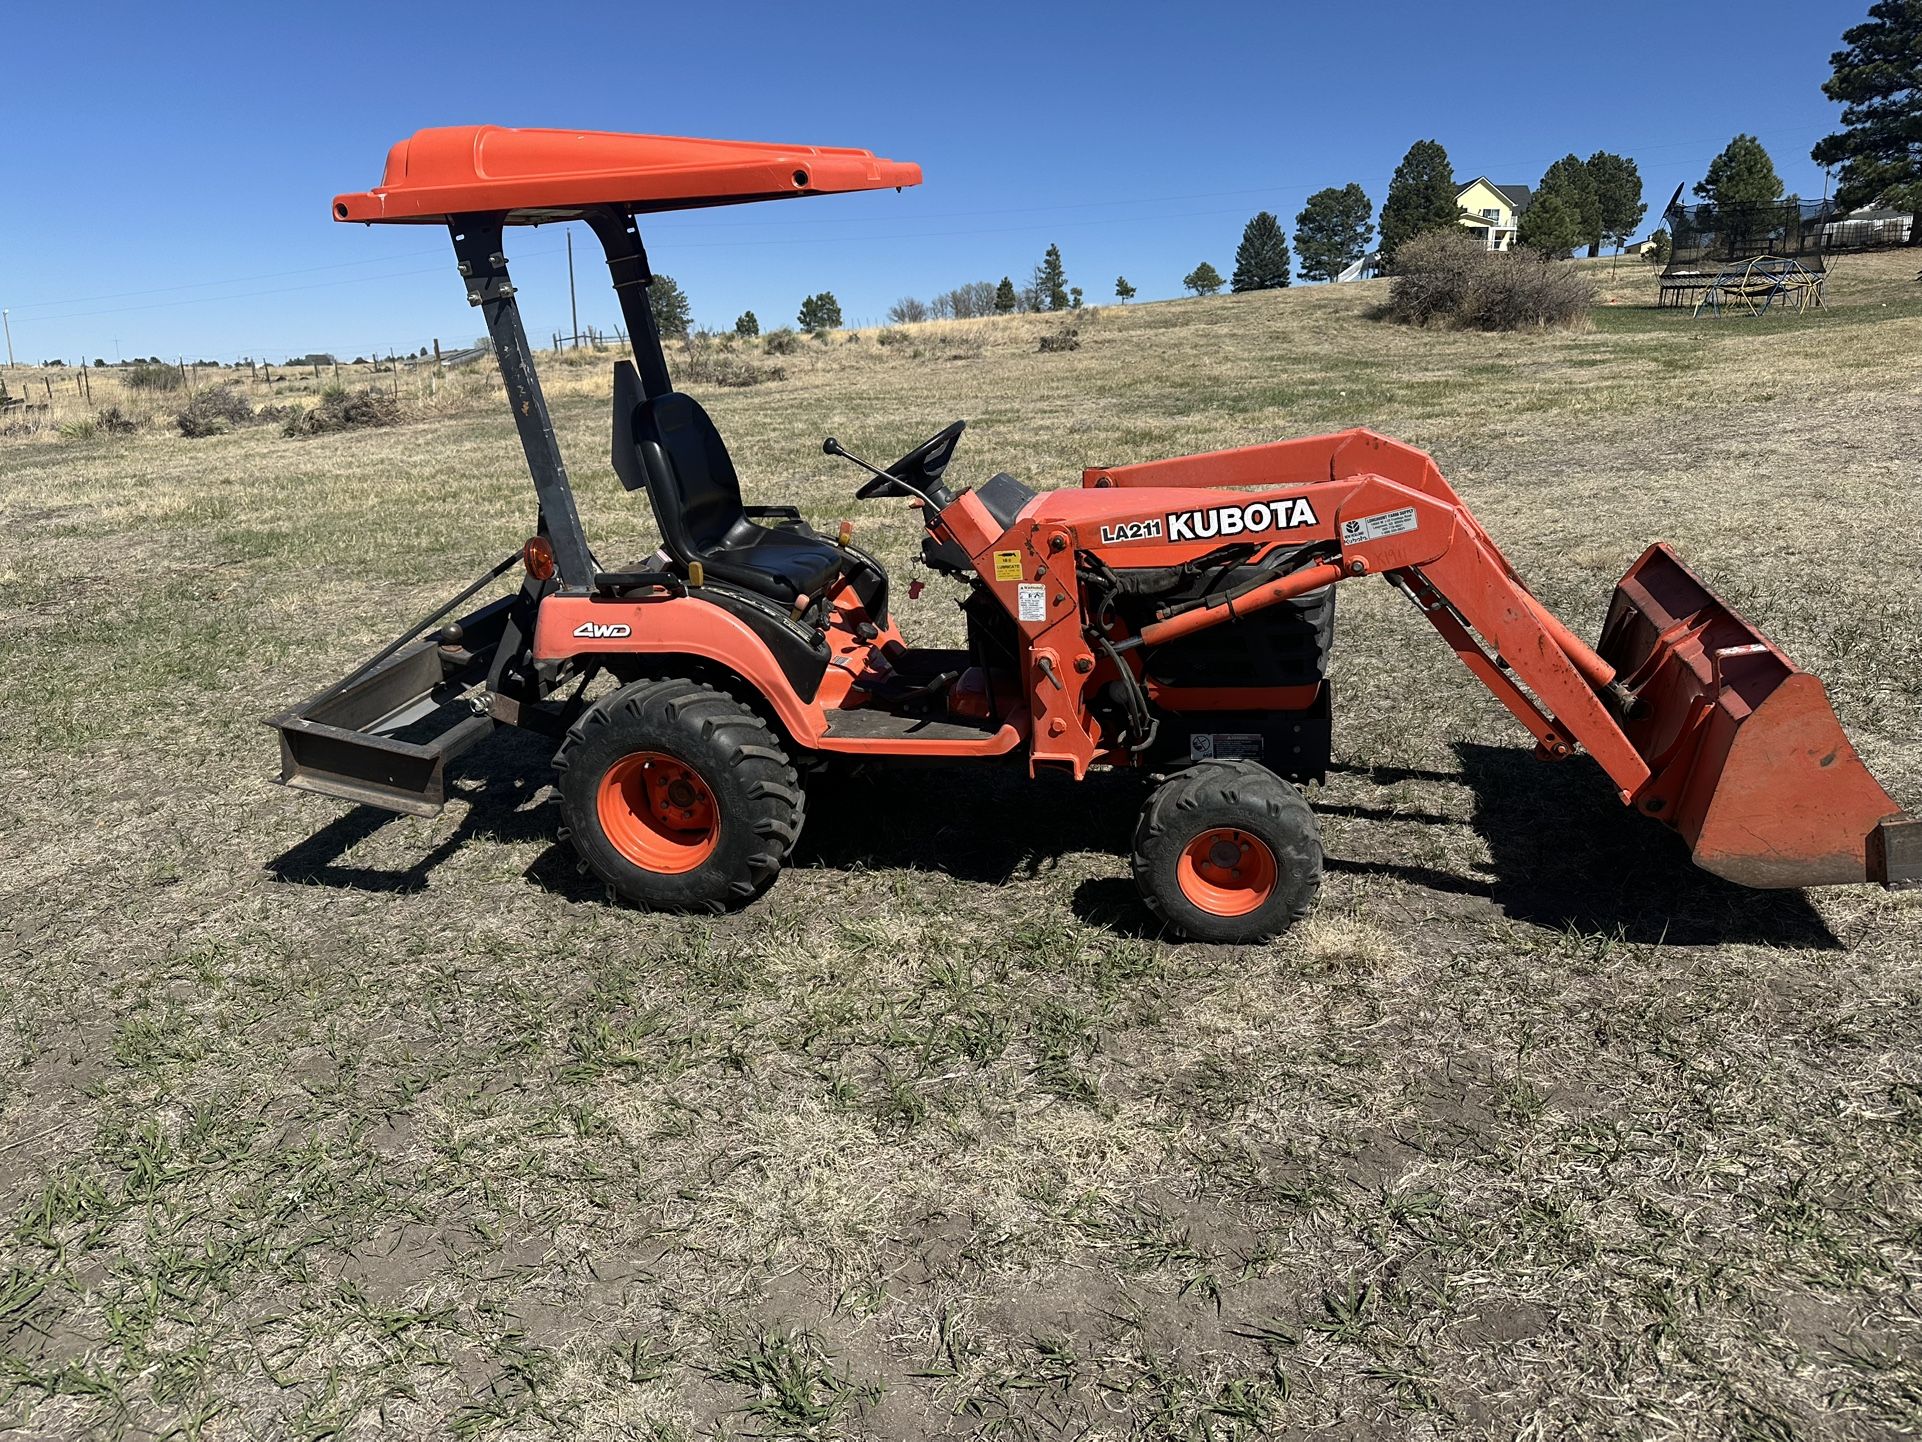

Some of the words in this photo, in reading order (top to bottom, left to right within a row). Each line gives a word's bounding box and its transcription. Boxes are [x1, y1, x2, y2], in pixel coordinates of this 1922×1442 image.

[1102, 520, 1162, 544] LA211
[1167, 497, 1318, 541] KUBOTA
[573, 621, 631, 638] 4WD
